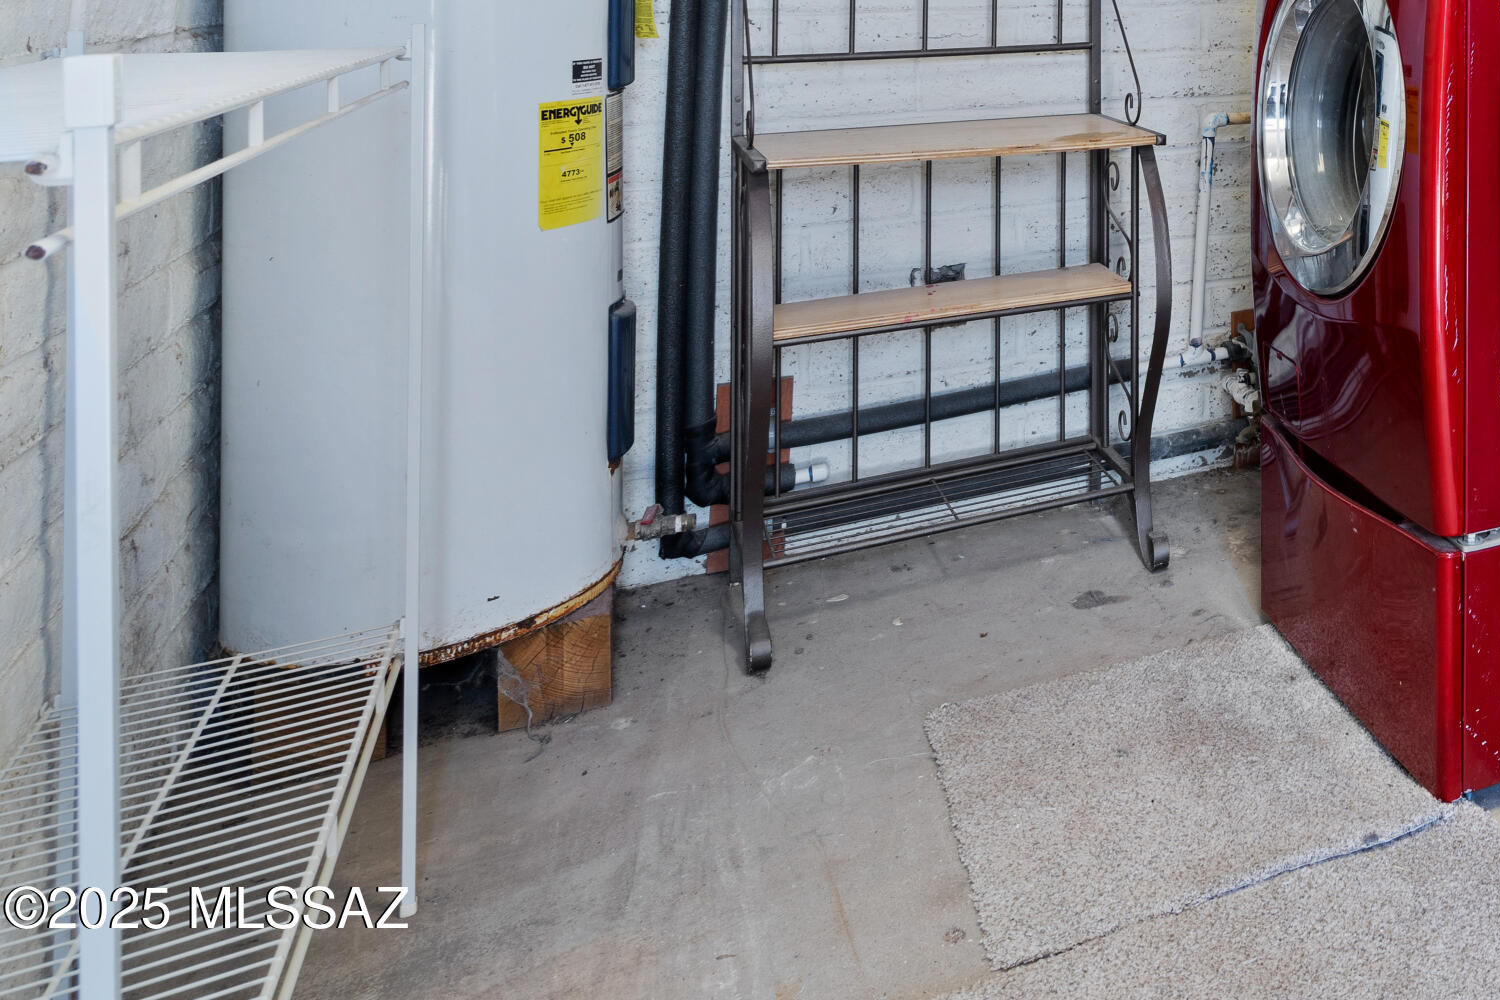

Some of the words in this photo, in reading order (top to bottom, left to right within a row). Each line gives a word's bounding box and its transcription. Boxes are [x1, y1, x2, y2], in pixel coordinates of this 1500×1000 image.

[541, 102, 602, 121] ENERGYGUIDE
[569, 131, 586, 143] 508
[561, 168, 581, 178] 4773
